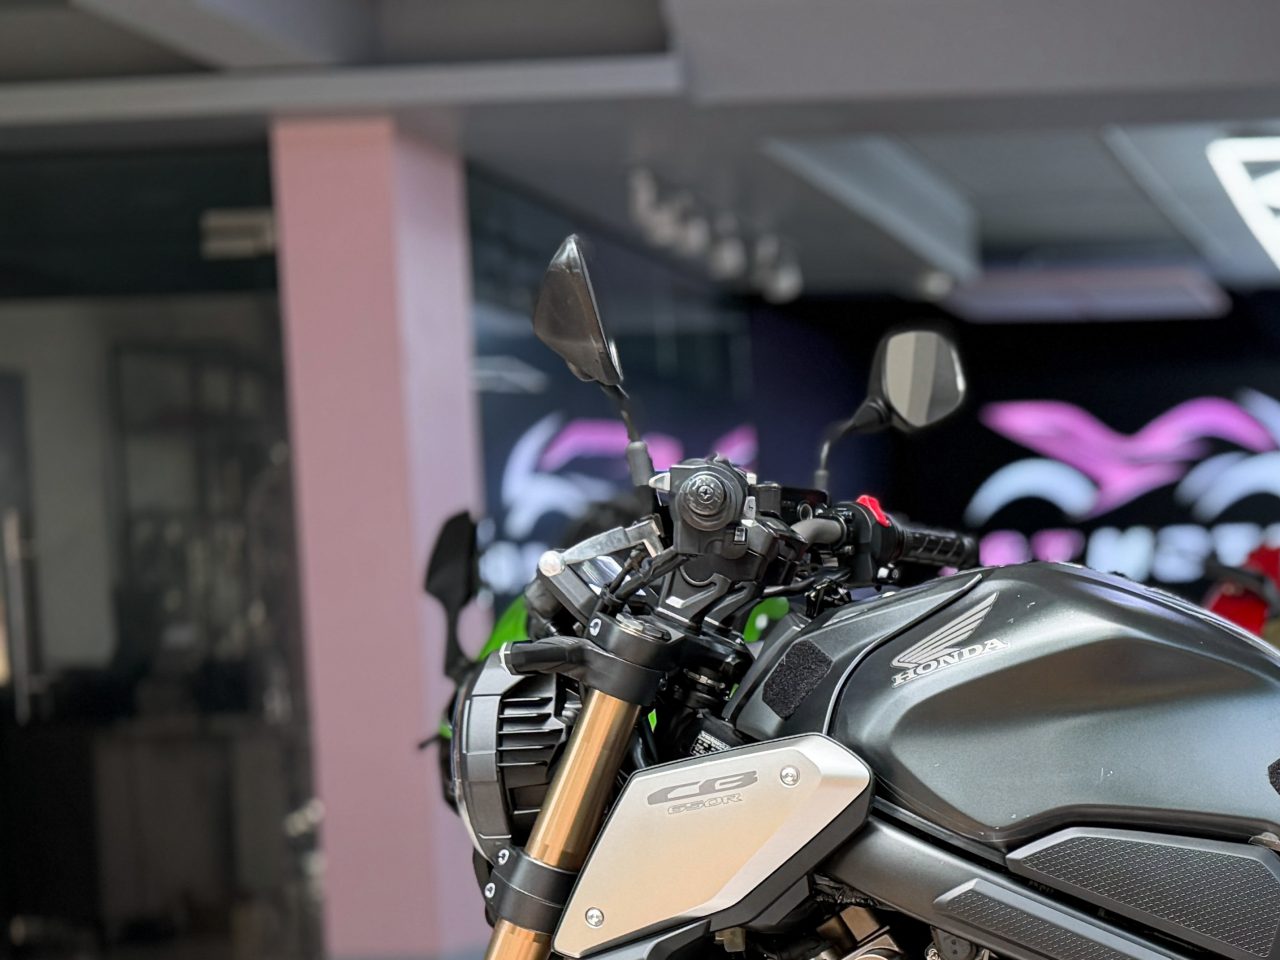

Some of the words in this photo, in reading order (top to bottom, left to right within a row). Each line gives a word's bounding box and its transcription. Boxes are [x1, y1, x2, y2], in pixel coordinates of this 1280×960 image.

[892, 638, 1009, 687] HONDA
[647, 770, 758, 805] CB
[668, 793, 743, 814] 650R
